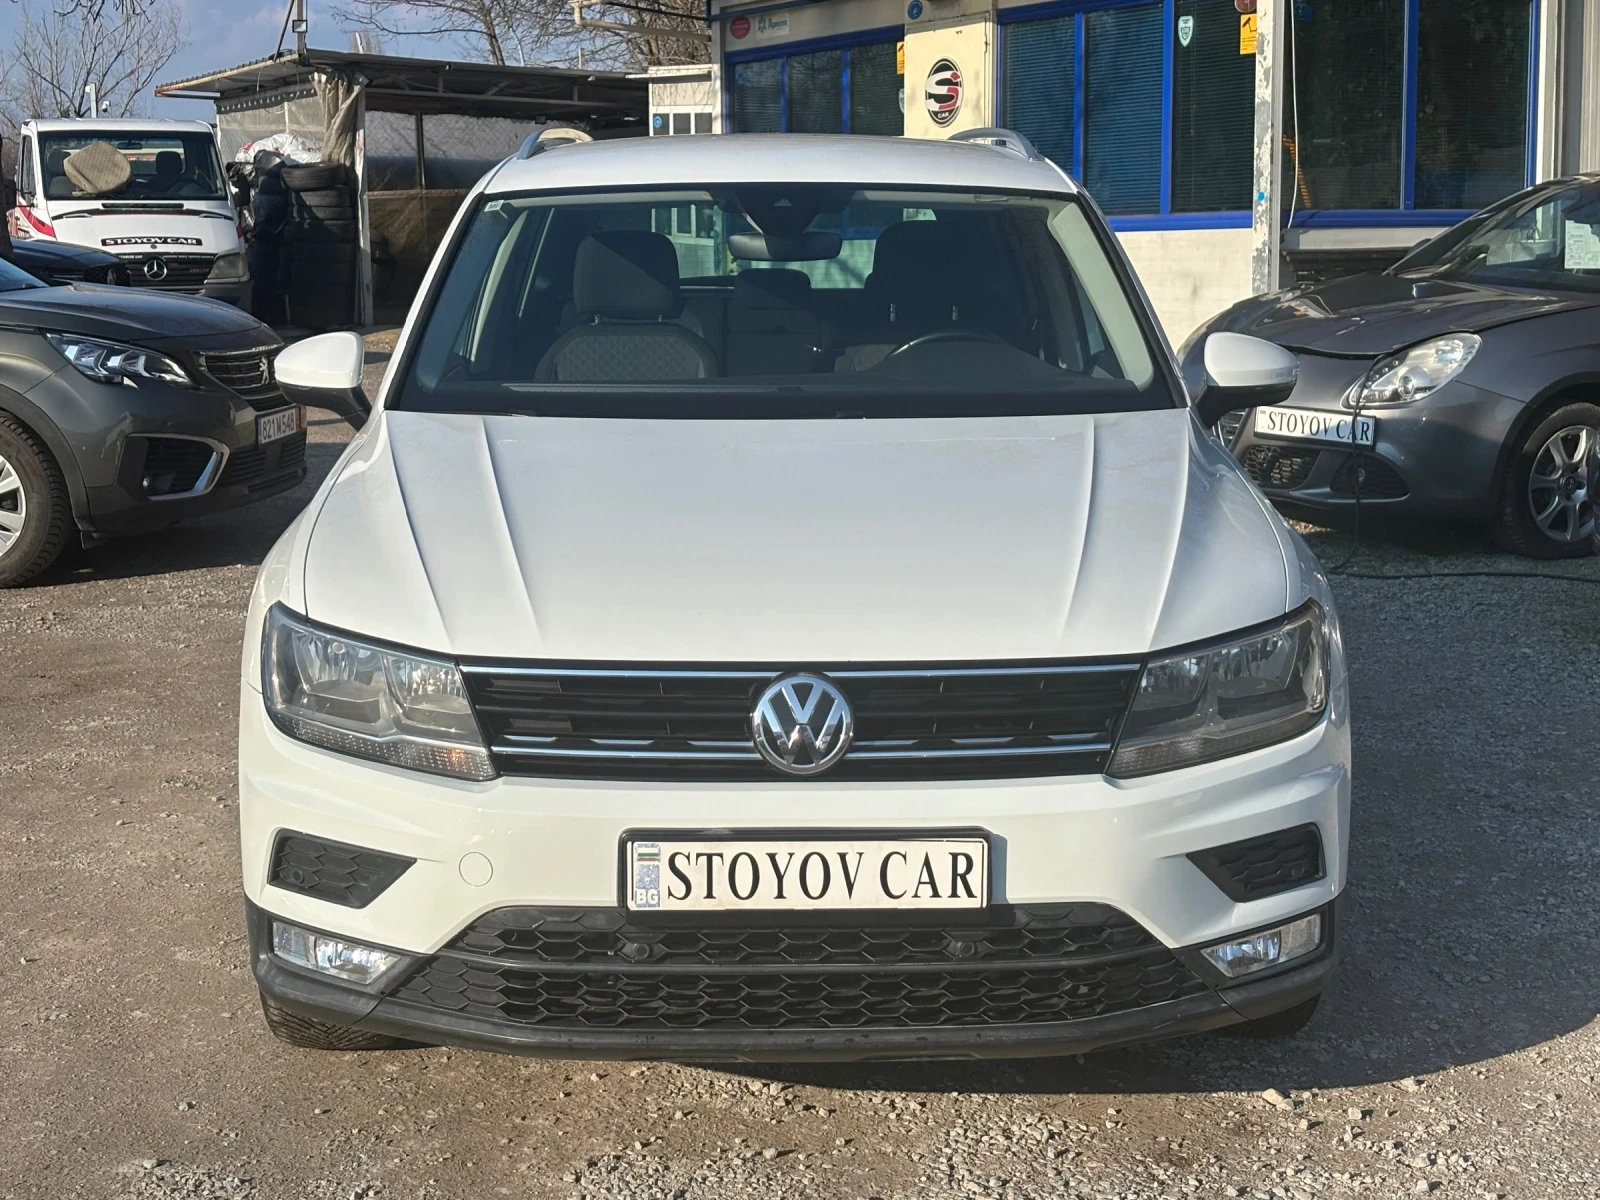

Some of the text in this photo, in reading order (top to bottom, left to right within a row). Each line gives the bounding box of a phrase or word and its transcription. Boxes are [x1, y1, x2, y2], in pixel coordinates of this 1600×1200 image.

[167, 237, 197, 245] CAR
[1267, 411, 1369, 442] STOYOV CAR
[667, 850, 978, 901] STOYOV CAR
[636, 888, 659, 904] BG
